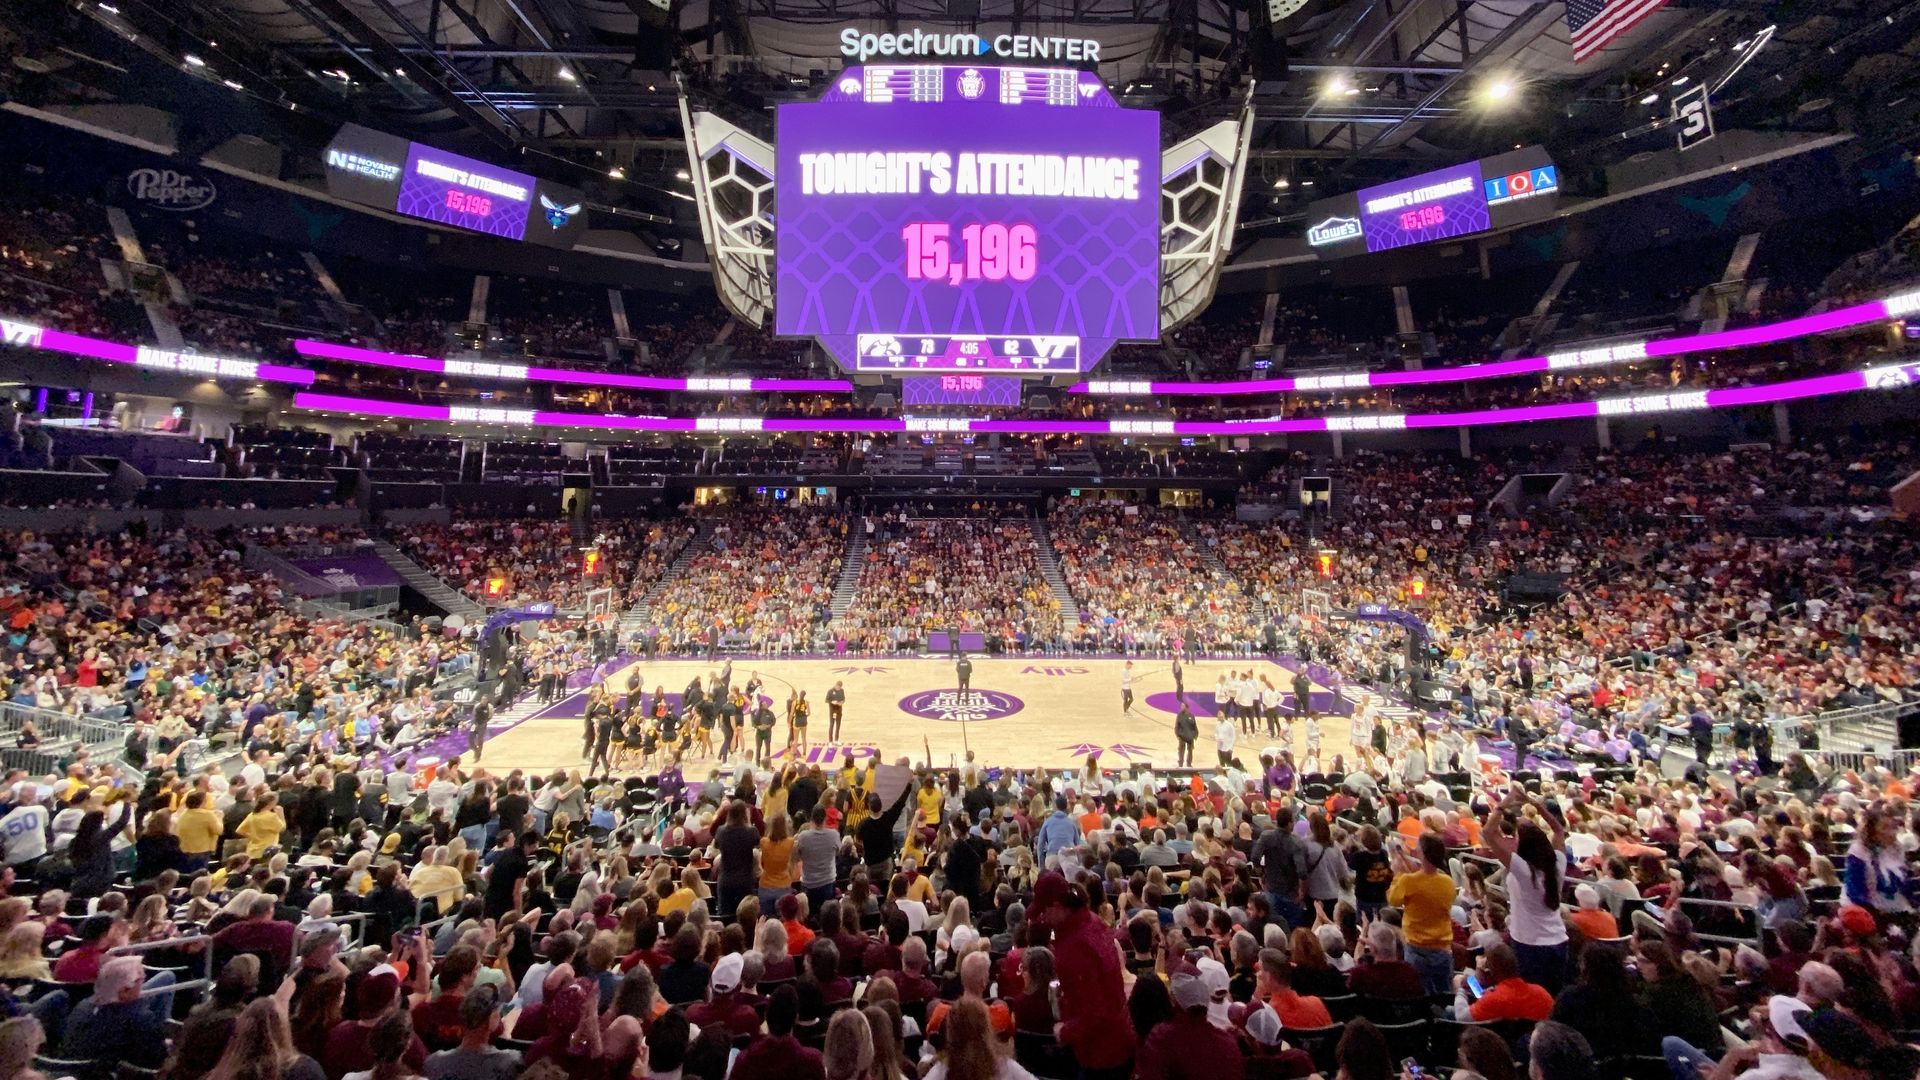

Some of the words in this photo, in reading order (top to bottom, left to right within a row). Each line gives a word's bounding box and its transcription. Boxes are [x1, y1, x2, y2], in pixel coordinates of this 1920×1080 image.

[840, 28, 979, 61] Spectrum
[994, 34, 1100, 61] CENTER
[356, 164, 393, 180] HEALTH
[357, 157, 400, 174] NOVANT
[128, 168, 210, 204] Pepper
[161, 169, 192, 187] Dr
[800, 152, 951, 194] TONIGHT'S
[956, 153, 1140, 200] ATTENDANCE
[446, 189, 492, 217] 15,196
[1400, 205, 1444, 230] 15,196
[1315, 222, 1356, 240] LOWE'S
[903, 222, 1037, 286] 15,196
[959, 342, 979, 354] 4:05
[1549, 353, 1580, 369] MAKE
[1580, 348, 1613, 365] SOME
[1612, 342, 1647, 360] NOISE
[137, 346, 178, 368] MAKE
[178, 352, 218, 372] SOME
[218, 358, 258, 377] NOISE
[941, 376, 983, 391] 15,196
[1599, 399, 1633, 414] MAKE
[1633, 395, 1669, 412] SOME
[1669, 391, 1710, 409] NOISE
[530, 604, 549, 613] ally
[1365, 605, 1382, 614] ally
[454, 690, 478, 703] ally
[1432, 688, 1453, 701] ally
[8, 812, 39, 837] 50
